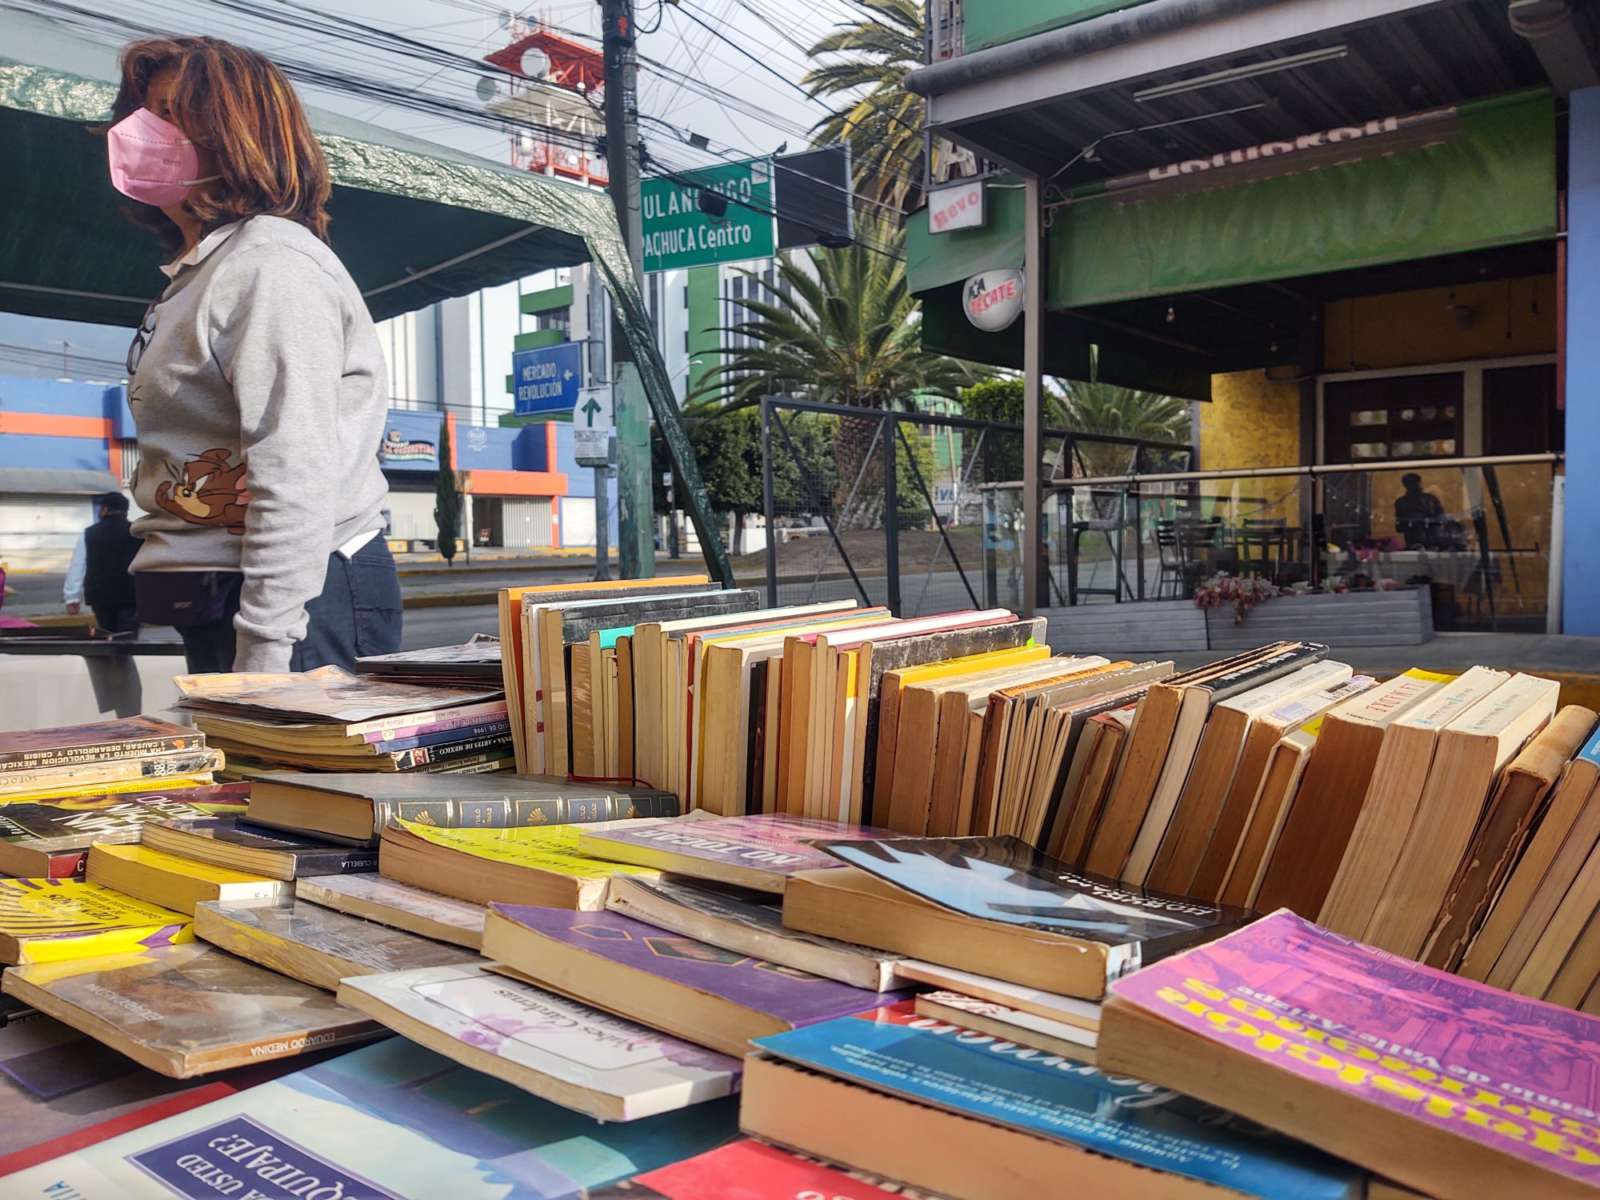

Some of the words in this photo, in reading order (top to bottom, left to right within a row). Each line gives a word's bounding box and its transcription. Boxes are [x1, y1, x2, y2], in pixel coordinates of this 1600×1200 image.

[644, 177, 751, 219] ULANNGO
[698, 224, 751, 250] Centro
[969, 280, 1016, 315] TECATE
[523, 362, 556, 381] MERCADO
[23, 751, 52, 760] CRISIS
[67, 744, 120, 756] DESARROLLO
[114, 748, 146, 757] MUERTO
[0, 759, 36, 769] MEXICA
[632, 829, 738, 854] TOCAR
[739, 849, 802, 866] NO
[249, 1041, 288, 1056] MEDINA
[176, 1154, 244, 1195] USTED
[207, 1134, 358, 1200] QUIPAJE?
